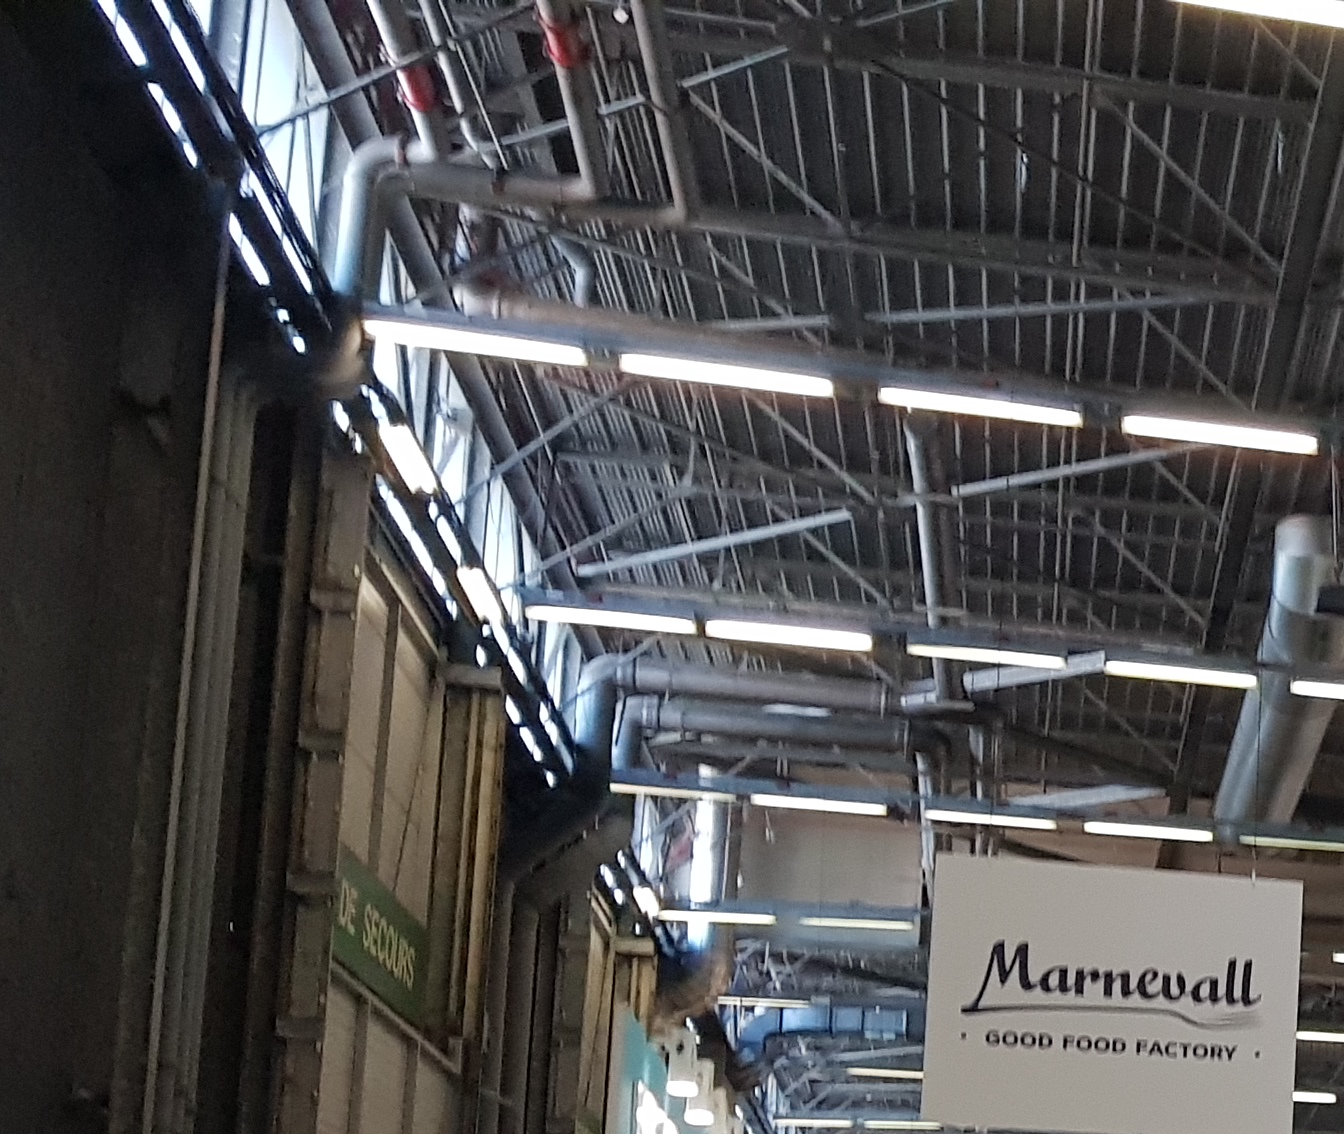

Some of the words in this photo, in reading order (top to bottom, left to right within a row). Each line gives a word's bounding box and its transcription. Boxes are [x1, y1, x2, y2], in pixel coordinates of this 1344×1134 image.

[340, 878, 358, 936] DE
[362, 902, 416, 992] SECOURS
[961, 938, 1262, 1013] Marnevall
[984, 1029, 1053, 1050] GOOD
[1061, 1033, 1127, 1056] FOOD
[1135, 1038, 1239, 1062] FACTORY
